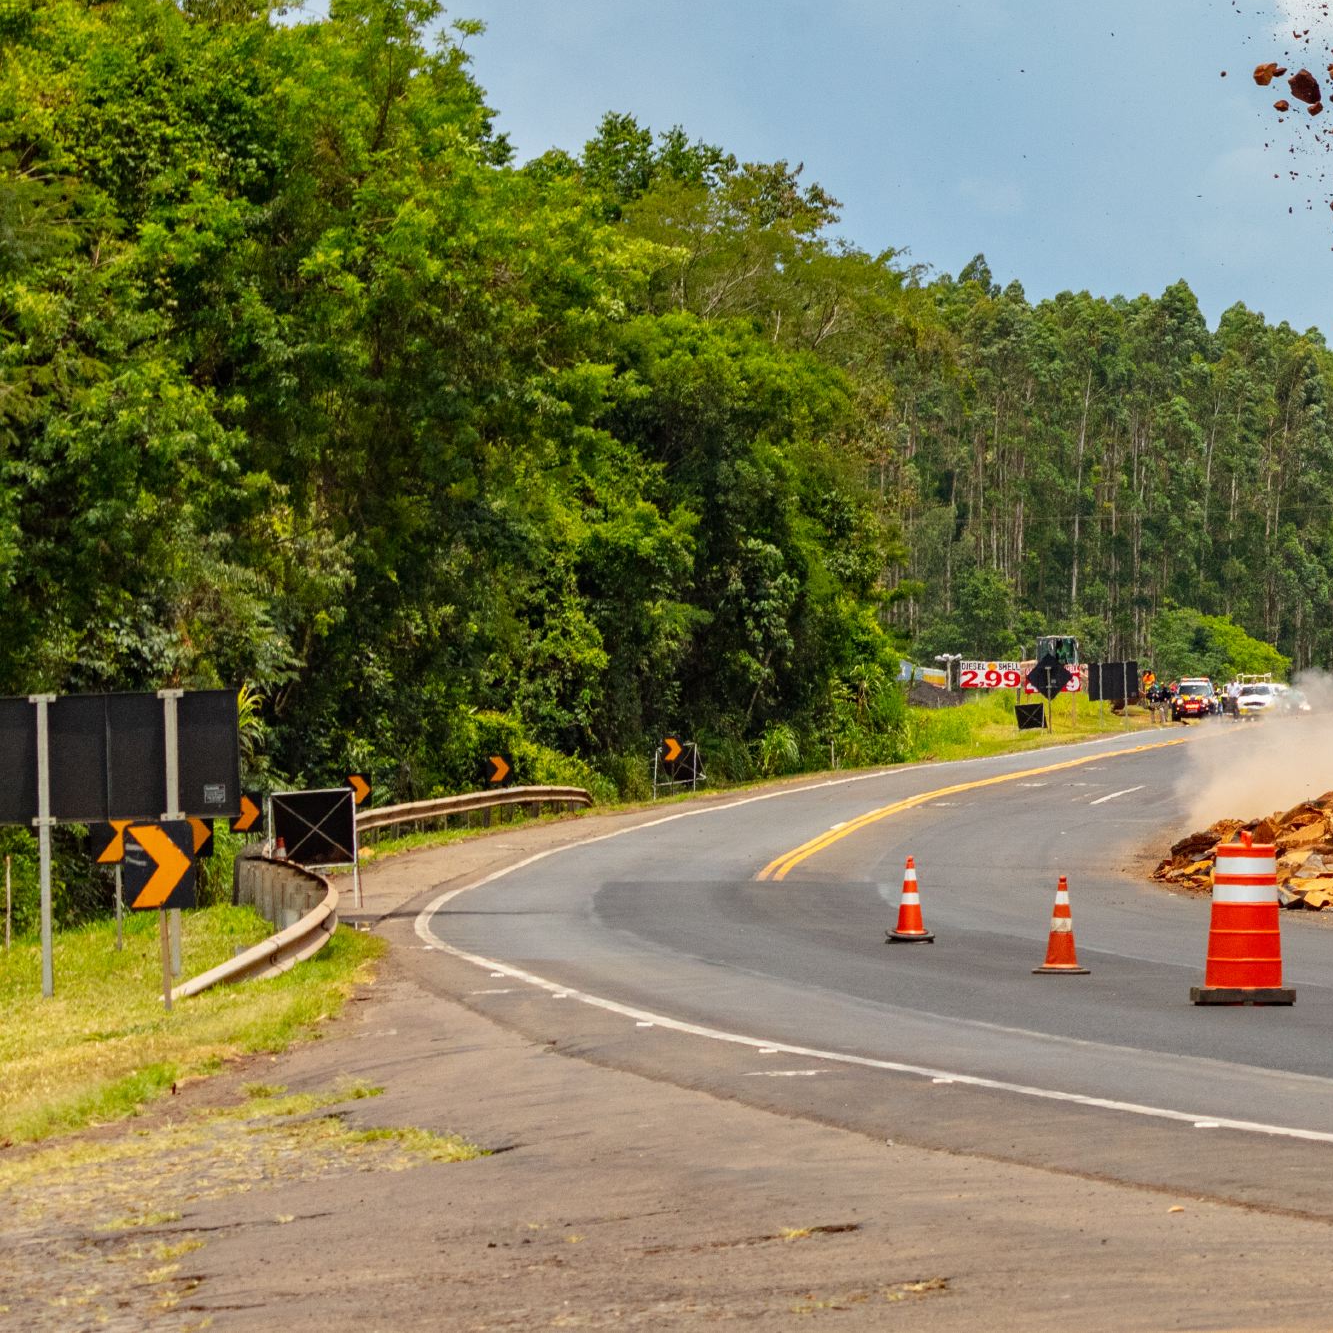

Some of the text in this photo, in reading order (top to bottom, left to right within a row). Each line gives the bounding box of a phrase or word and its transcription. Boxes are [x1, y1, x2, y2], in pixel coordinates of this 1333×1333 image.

[961, 662, 1020, 670] DIESEL SHELL
[960, 670, 1021, 688] 2,99
